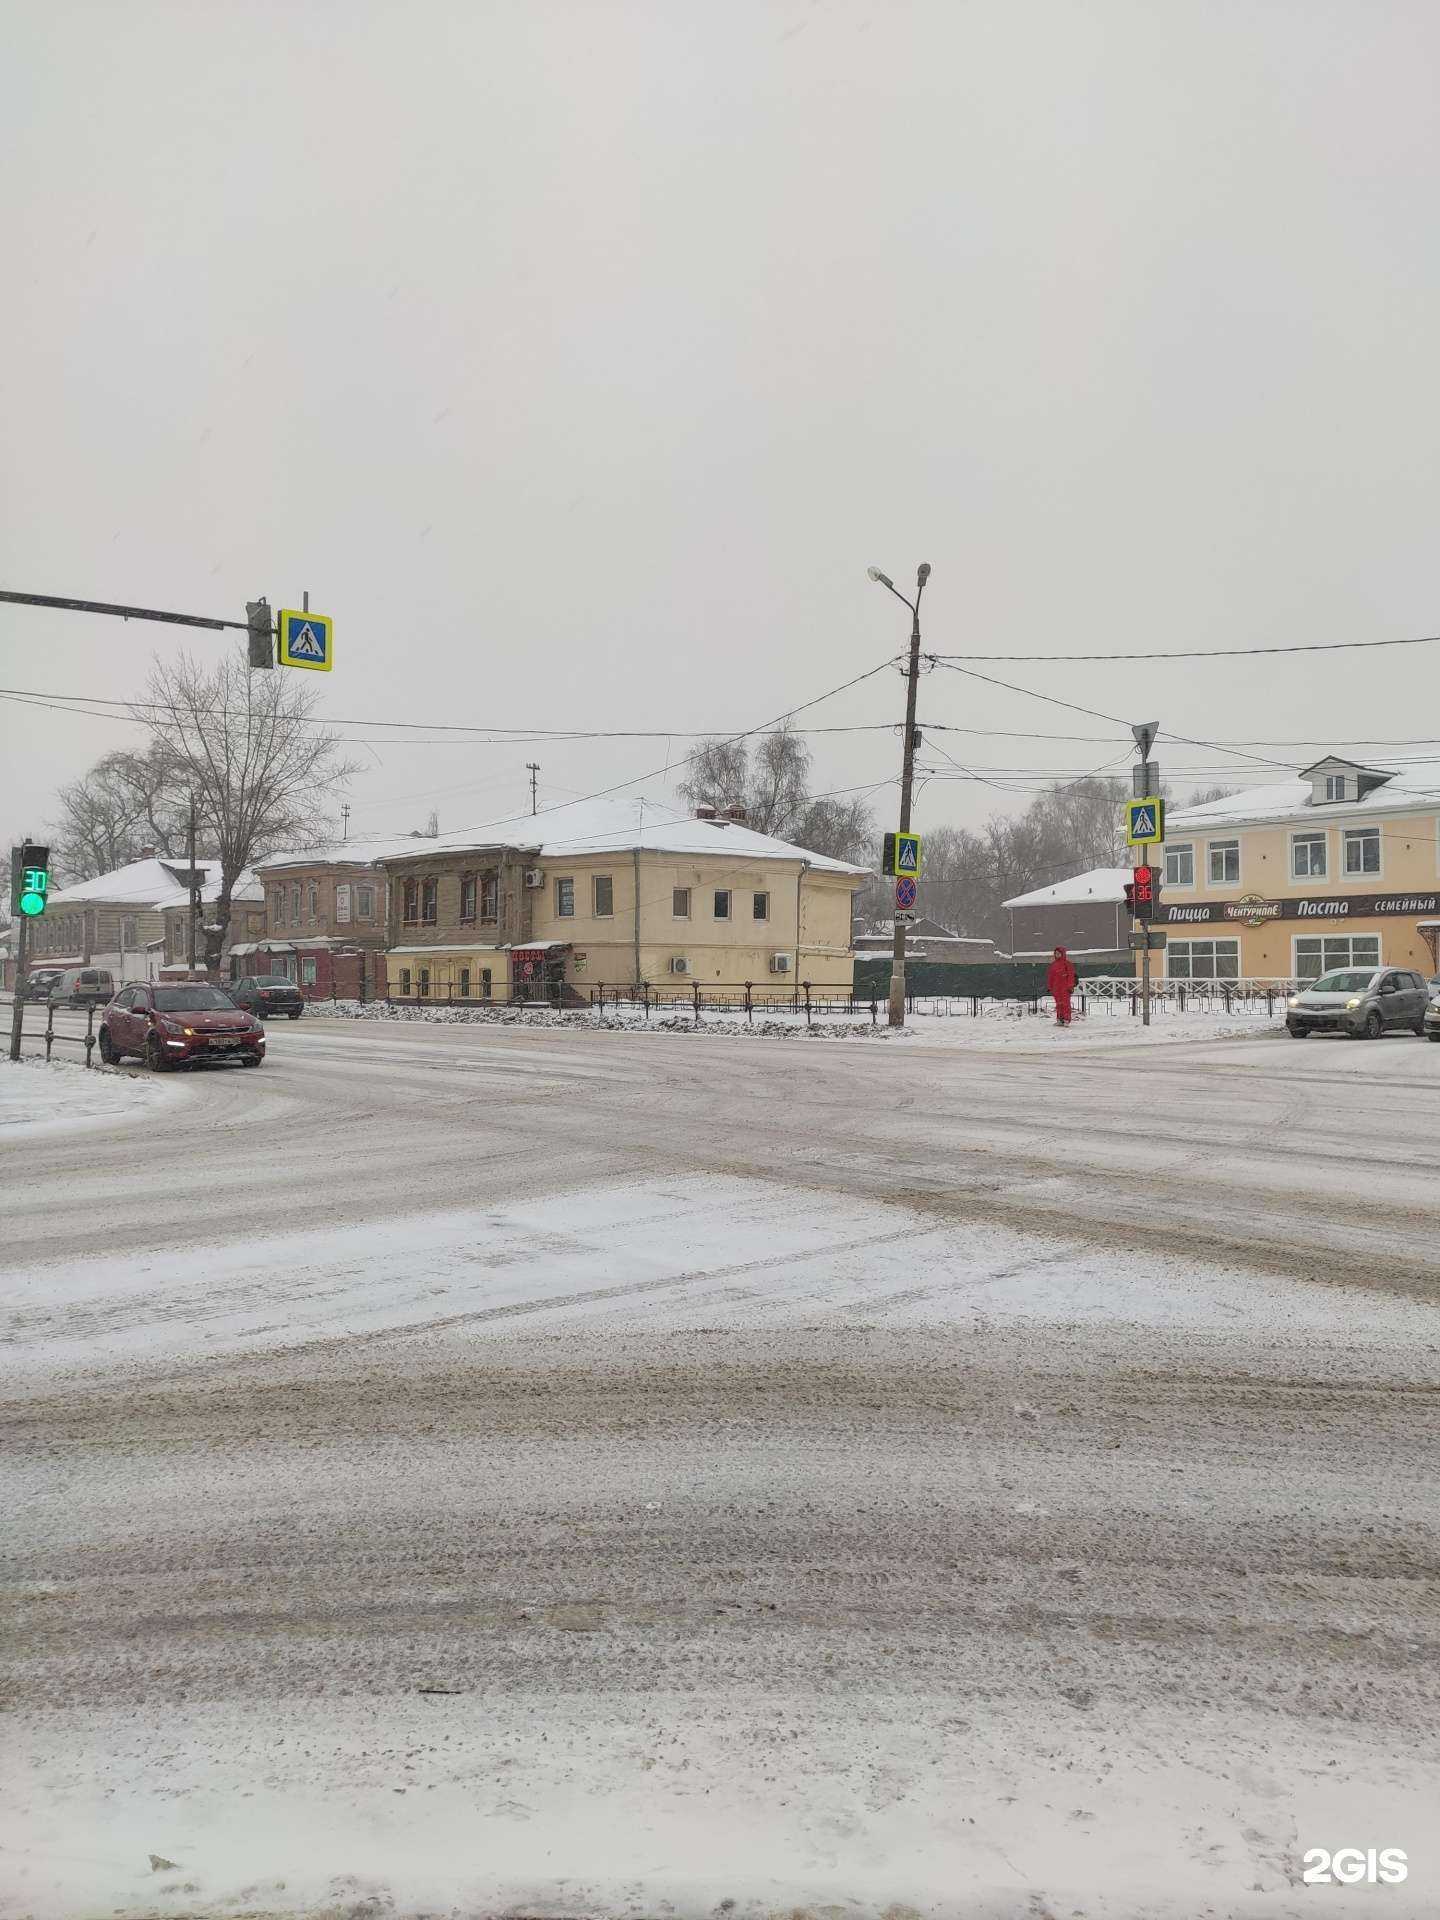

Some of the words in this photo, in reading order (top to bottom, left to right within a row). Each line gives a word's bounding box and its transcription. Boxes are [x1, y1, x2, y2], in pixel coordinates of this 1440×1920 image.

[25, 870, 47, 891] 30
[1297, 900, 1349, 916] Паста
[1374, 897, 1436, 911] СЕМЕЙНЫЙ
[1168, 906, 1210, 922] Пицца
